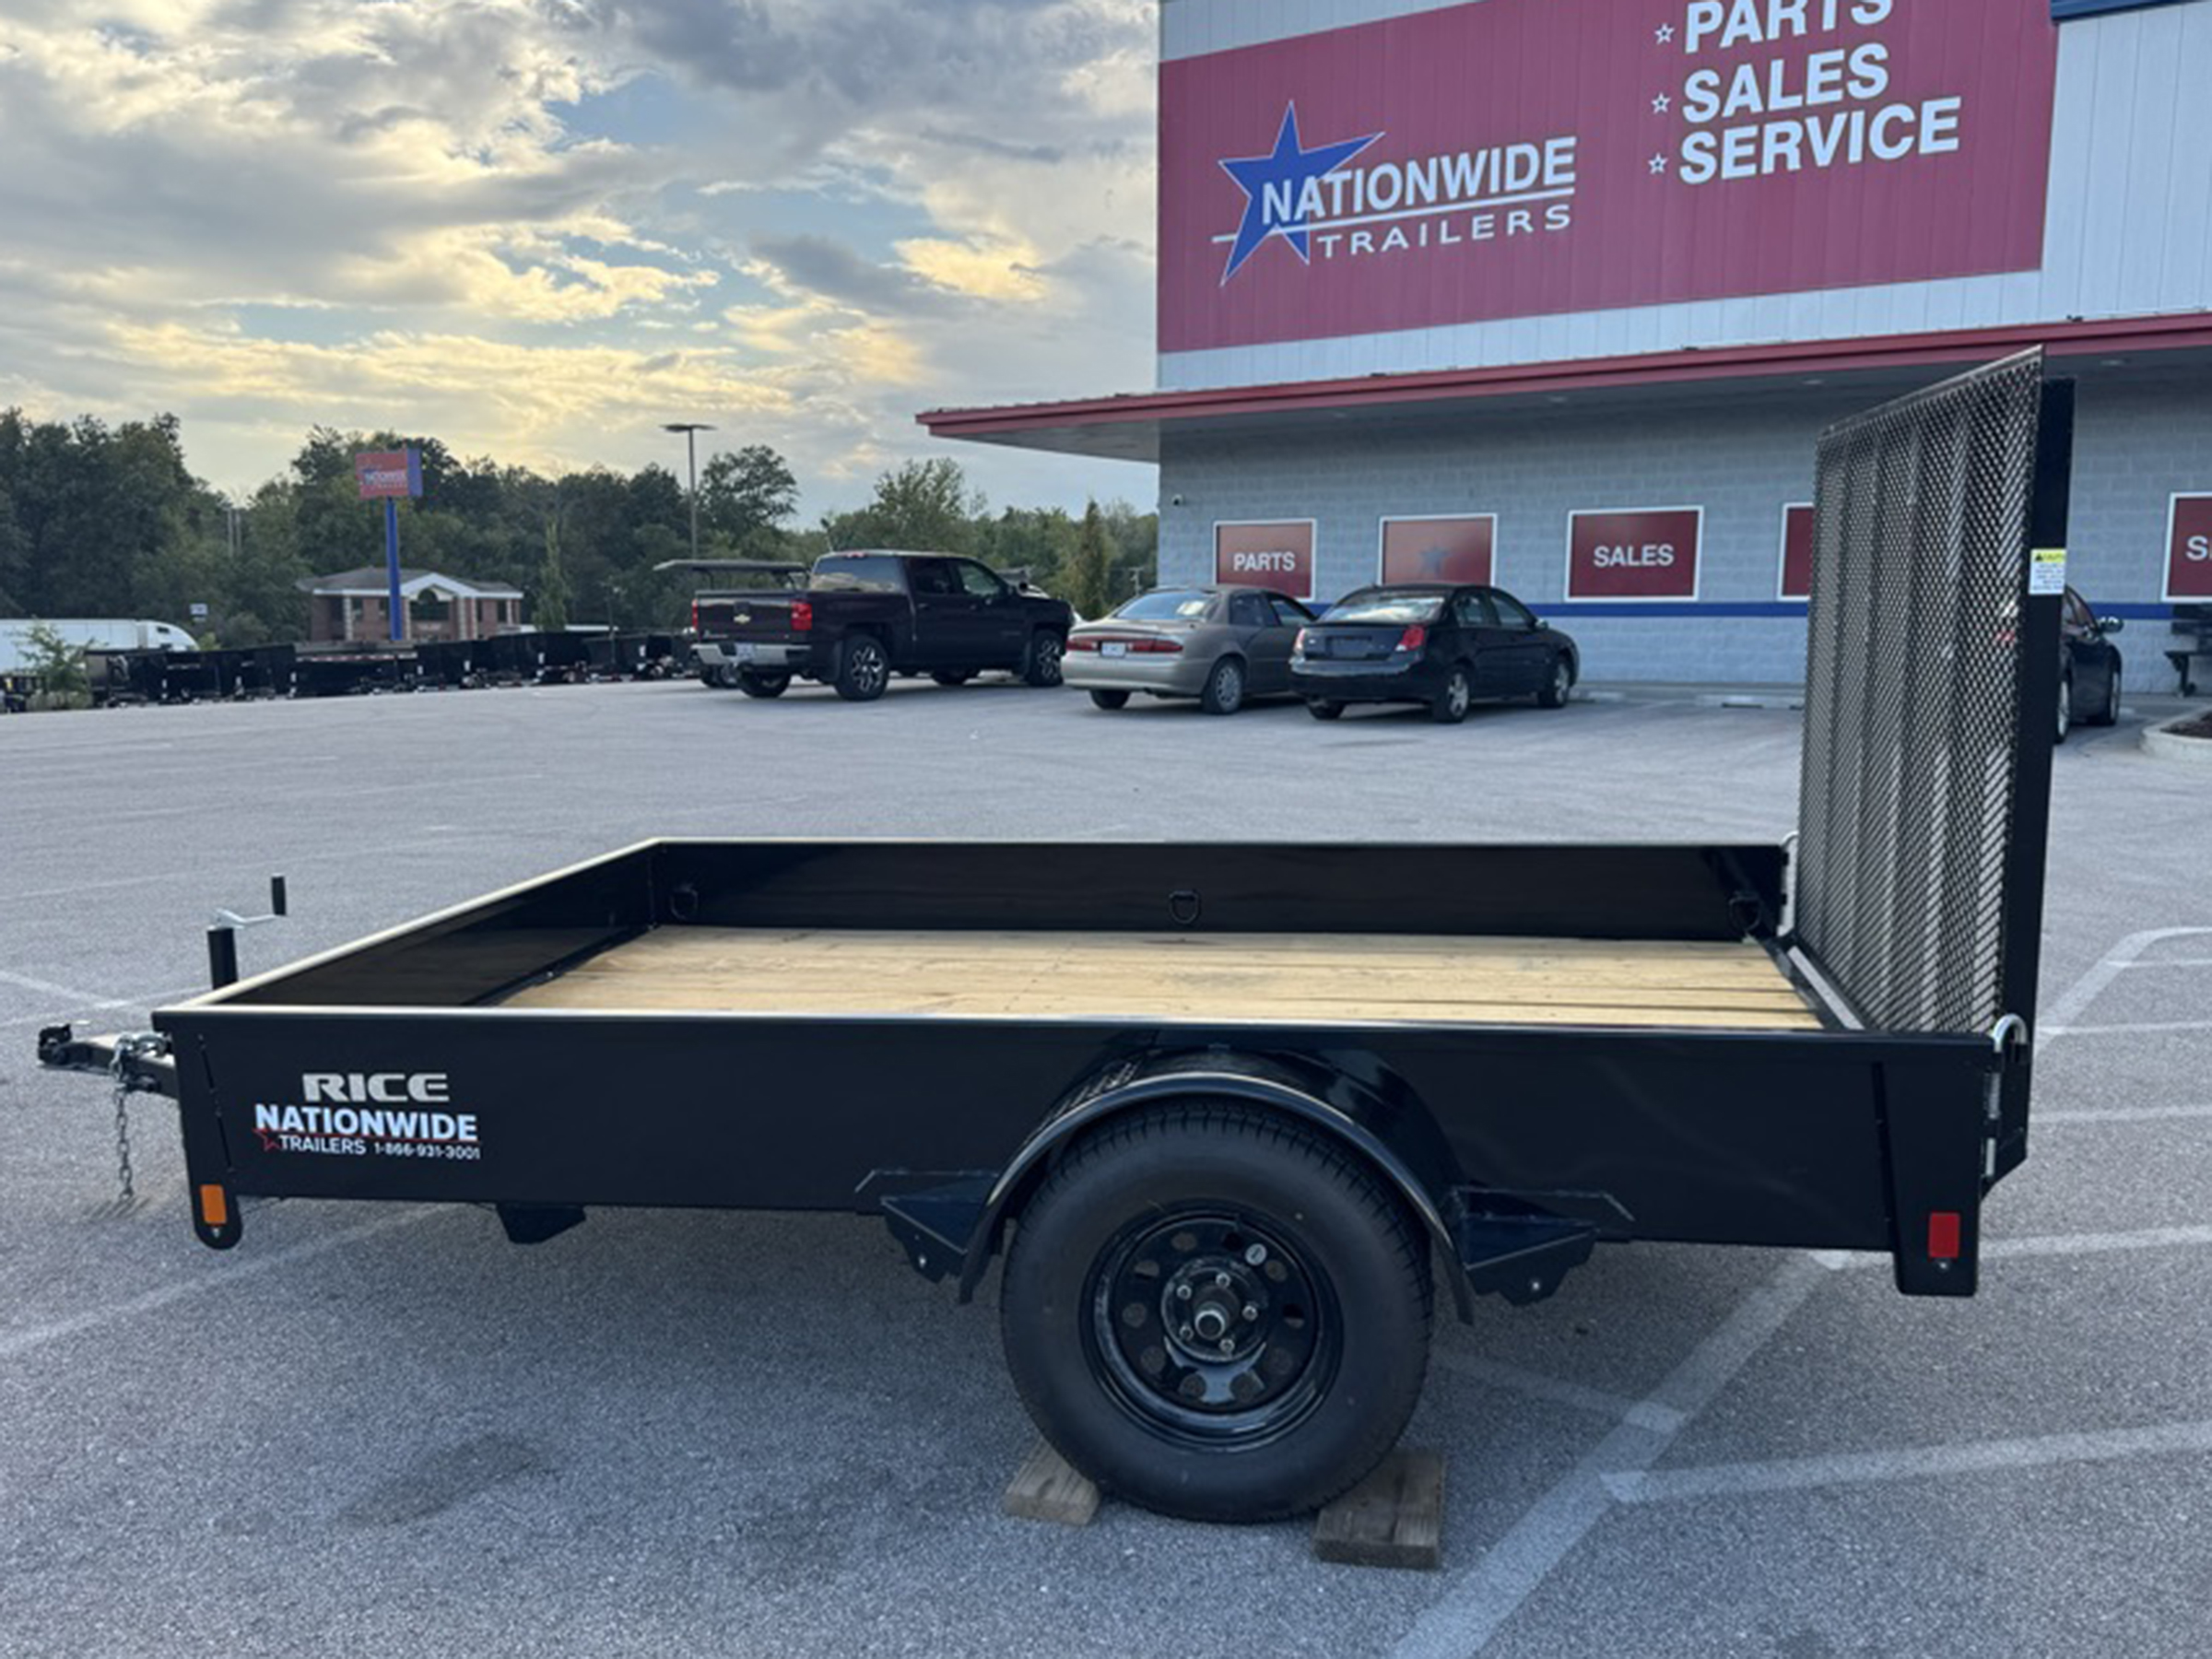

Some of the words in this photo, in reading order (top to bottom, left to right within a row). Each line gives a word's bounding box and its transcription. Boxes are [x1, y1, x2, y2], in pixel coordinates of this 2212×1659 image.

[1682, 42, 1888, 124] SALES
[1679, 96, 1960, 185] SERVICE
[1262, 136, 1577, 225] NATIONWIDE
[1317, 205, 1571, 259] TRAILERS
[1233, 551, 1296, 571] PARTS
[1593, 544, 1675, 568] SALES
[2185, 535, 2212, 561] S
[302, 1073, 450, 1102] RICE
[254, 1104, 478, 1141] NATIONWIDE
[278, 1135, 368, 1156] TRAILERS
